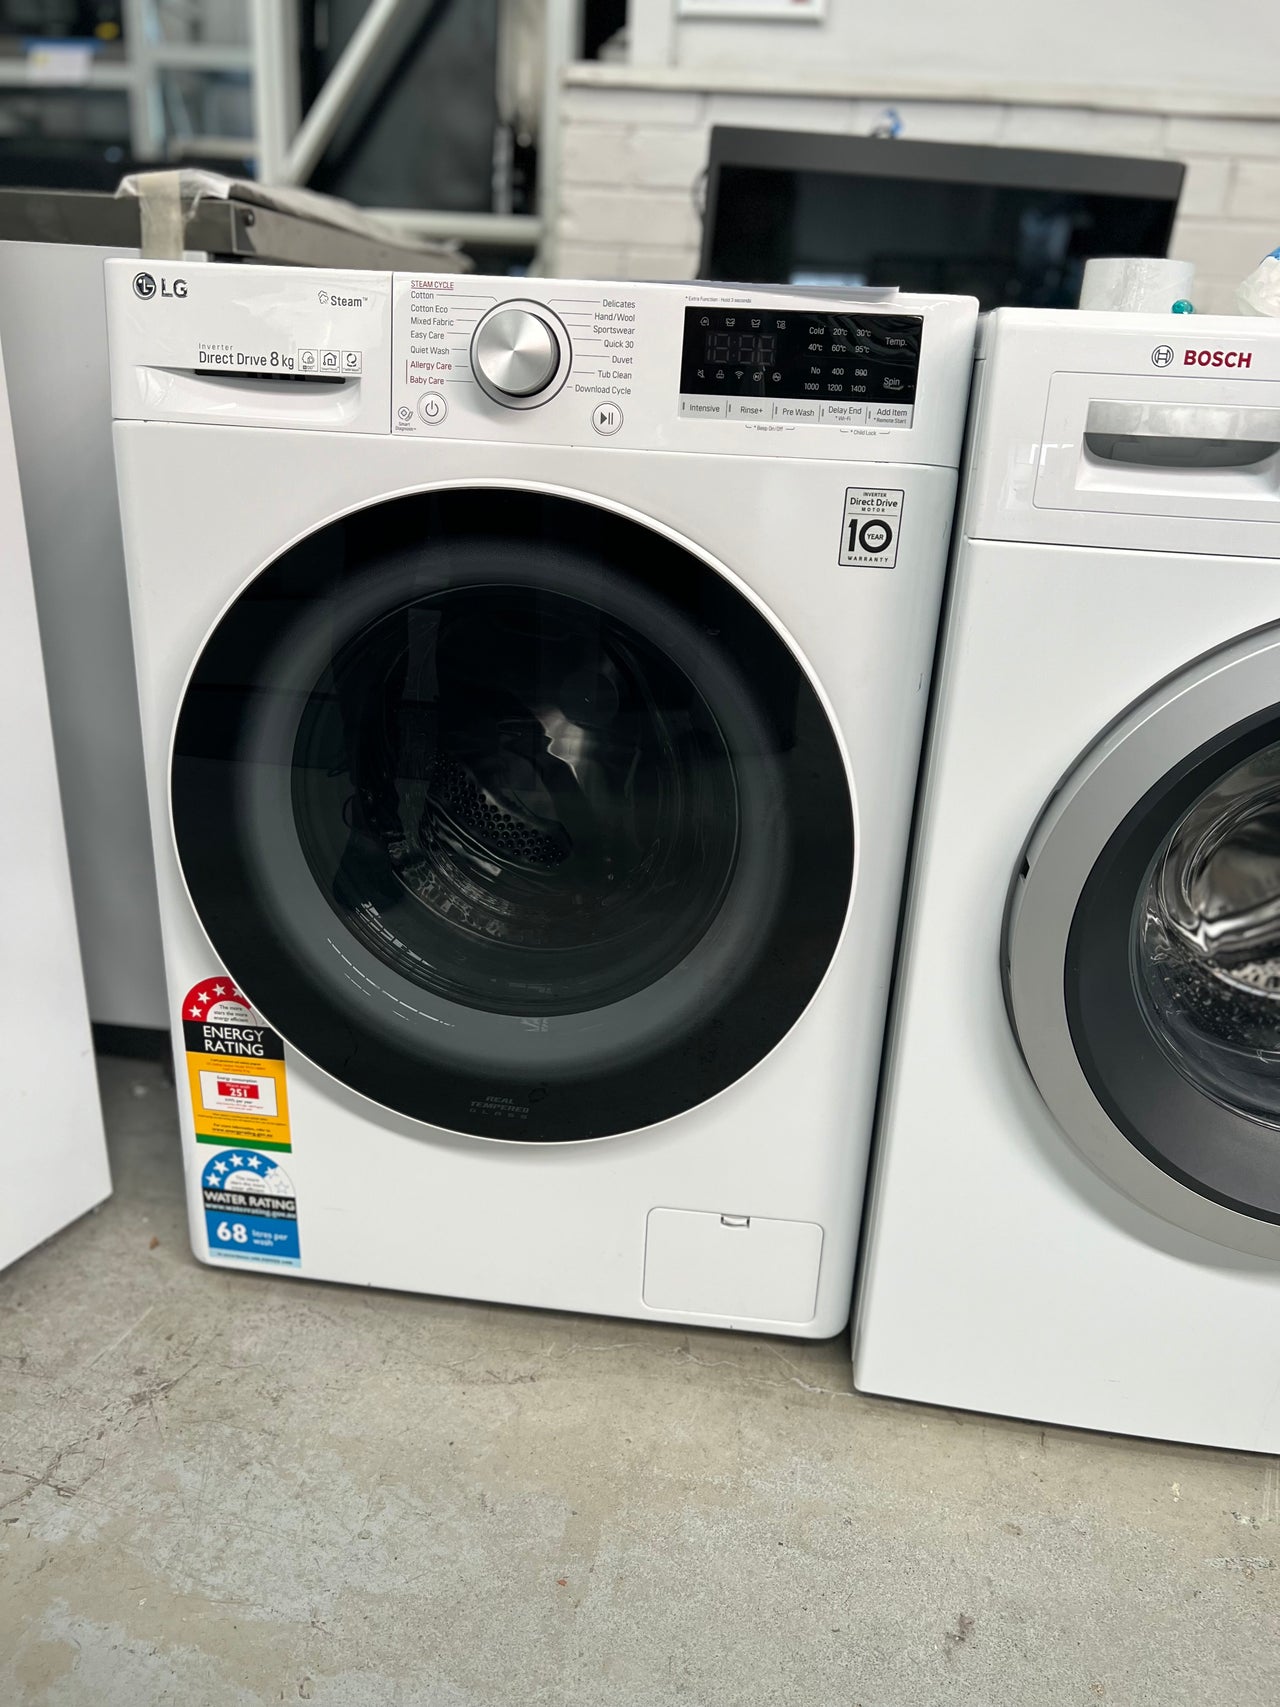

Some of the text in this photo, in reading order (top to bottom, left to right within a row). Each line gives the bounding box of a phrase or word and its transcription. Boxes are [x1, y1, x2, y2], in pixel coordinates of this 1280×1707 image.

[161, 278, 188, 298] LG
[410, 280, 454, 290] STEAM CYCLE
[410, 291, 434, 299] Cotton
[410, 304, 448, 314] Cotton Eco
[603, 299, 636, 309] Delicates
[410, 317, 454, 327] Mixed Fabric
[594, 313, 635, 322] Hand/Wool
[410, 330, 445, 340] Easy Care
[593, 326, 635, 336] Sportswear
[809, 327, 825, 335] Cold
[198, 343, 234, 351] Inverter
[604, 339, 634, 349] Quick 30
[885, 337, 907, 347] Temp.
[410, 346, 450, 355] Quiet Wash
[199, 351, 234, 366] Direct
[236, 353, 267, 367] Drive
[270, 352, 279, 366] 8
[281, 355, 295, 370] kg
[612, 355, 633, 365] Duvet
[1183, 350, 1252, 368] BOSCH
[410, 361, 452, 371] Allergy Care
[598, 370, 632, 380] Tub Clean
[810, 366, 868, 377] No 400 800
[410, 376, 445, 385] Baby Care
[883, 377, 901, 388] Spin
[575, 385, 632, 395] Download Cycle
[804, 382, 867, 393] 1000 1200 1400
[689, 404, 720, 413] Intensive
[740, 405, 763, 415] Rinse+
[782, 408, 815, 417] Pre Wash
[828, 405, 862, 415] Delay End
[876, 408, 908, 417] Add Item
[850, 497, 898, 507] Direct Drive
[848, 519, 893, 553] 10
[203, 1026, 264, 1042] ENERGY
[204, 1039, 264, 1056] RATING
[229, 1087, 248, 1098] 251
[471, 1101, 529, 1113] TEMPERED
[204, 1190, 296, 1212] WATER RATING
[216, 1221, 248, 1244] 68
[273, 1233, 288, 1242] per
